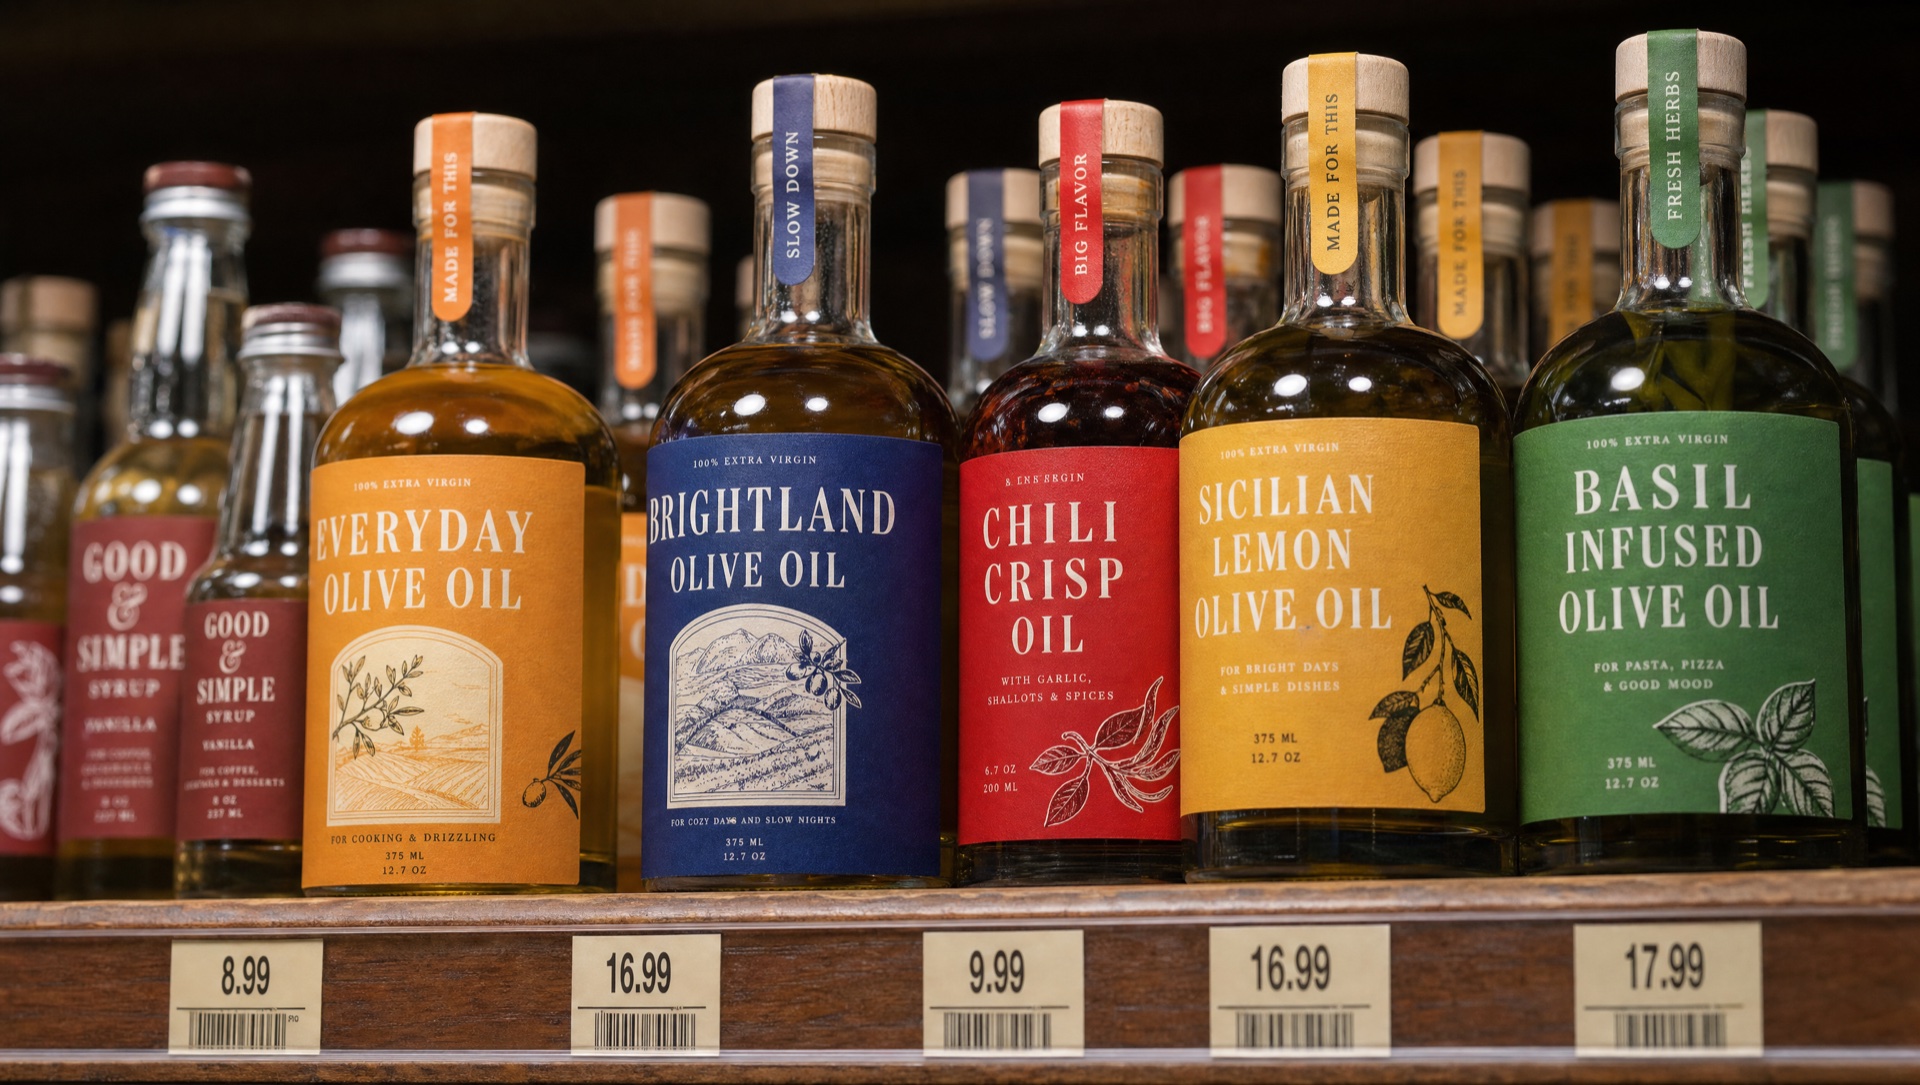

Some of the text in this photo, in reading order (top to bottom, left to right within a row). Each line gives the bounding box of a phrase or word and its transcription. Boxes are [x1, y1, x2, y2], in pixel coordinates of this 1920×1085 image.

[1666, 71, 1683, 220] FRESH HERBS
[1325, 93, 1341, 251] MADE FOR THIS
[786, 131, 800, 258] SLOW DOWN
[443, 152, 458, 302] MADE FOR THIS
[1074, 153, 1088, 276] BIG FLAVOR
[1454, 169, 1467, 318] MADE FOR THIS
[976, 217, 996, 339] SLOW DOWN
[1196, 215, 1213, 334] BIG FLAVOR
[1220, 442, 1339, 460] 100% EXTRA VIRGIN
[1587, 434, 1728, 450] 100% EXTRA VIRGIN
[693, 455, 817, 468] 100% EXTRA VIRGIN
[354, 478, 471, 492] 100% EXTRA VIRGIN
[1199, 474, 1374, 525] SICILIAN
[1574, 464, 1751, 516] BASIL
[649, 486, 896, 545] BRIGHTLAND
[983, 501, 1117, 549] CHILI
[317, 509, 533, 561] EVERYDAY
[1213, 528, 1352, 577] LEMON
[1566, 524, 1762, 574] INFUSED
[83, 540, 188, 583] GOOD
[670, 551, 763, 594] OLIVE
[780, 550, 845, 588] OIL
[323, 567, 522, 616] OLIVE OIL
[984, 557, 1124, 605] CRISP
[107, 583, 147, 631] &
[204, 611, 270, 639] GOOD
[1195, 587, 1392, 639] OLIVE OIL
[1559, 584, 1779, 634] OLIVE OIL
[77, 634, 185, 672] SIMPLE
[1011, 615, 1083, 655] OIL
[219, 640, 246, 674] &
[1220, 662, 1339, 676] FOR BRIGHT DAYS
[1594, 659, 1724, 673] FOR PASTA, PIZZA
[88, 679, 161, 699] SYRUP
[197, 677, 275, 705] SIMPLE
[987, 691, 1114, 705] SHALLOTS & SPICES
[1001, 673, 1092, 685] WITH GARLIC,
[1220, 681, 1340, 695] & SIMPLE DISHES
[1604, 679, 1713, 692] & GOOD MOOD
[206, 710, 256, 724] SYRUP
[202, 739, 254, 751] VANILLA
[1254, 733, 1298, 744] 375 ML
[985, 764, 1016, 775] 6.7 OZ
[1252, 752, 1301, 764] 12.7 OZ
[1608, 757, 1656, 769] 375 ML
[984, 782, 1018, 793] 200 ML
[1605, 777, 1659, 789] 12.7 OZ
[331, 833, 496, 845] FOR COOKING & DRIZZLING
[671, 819, 685, 827] FOR
[688, 818, 709, 826] COZY
[741, 816, 761, 824] AND
[765, 816, 793, 824] SLOW
[798, 816, 836, 824] NIGHTS
[386, 851, 424, 860] 375 ML
[723, 852, 766, 861] 12.7 OZ
[725, 838, 764, 847] 375 ML
[383, 866, 427, 875] 12.7 OZ
[222, 956, 270, 995] 8.99
[606, 951, 671, 994] 16.99
[969, 950, 1024, 993] 9.99
[1251, 944, 1331, 991] 16.99
[1625, 942, 1705, 989] 17.99
